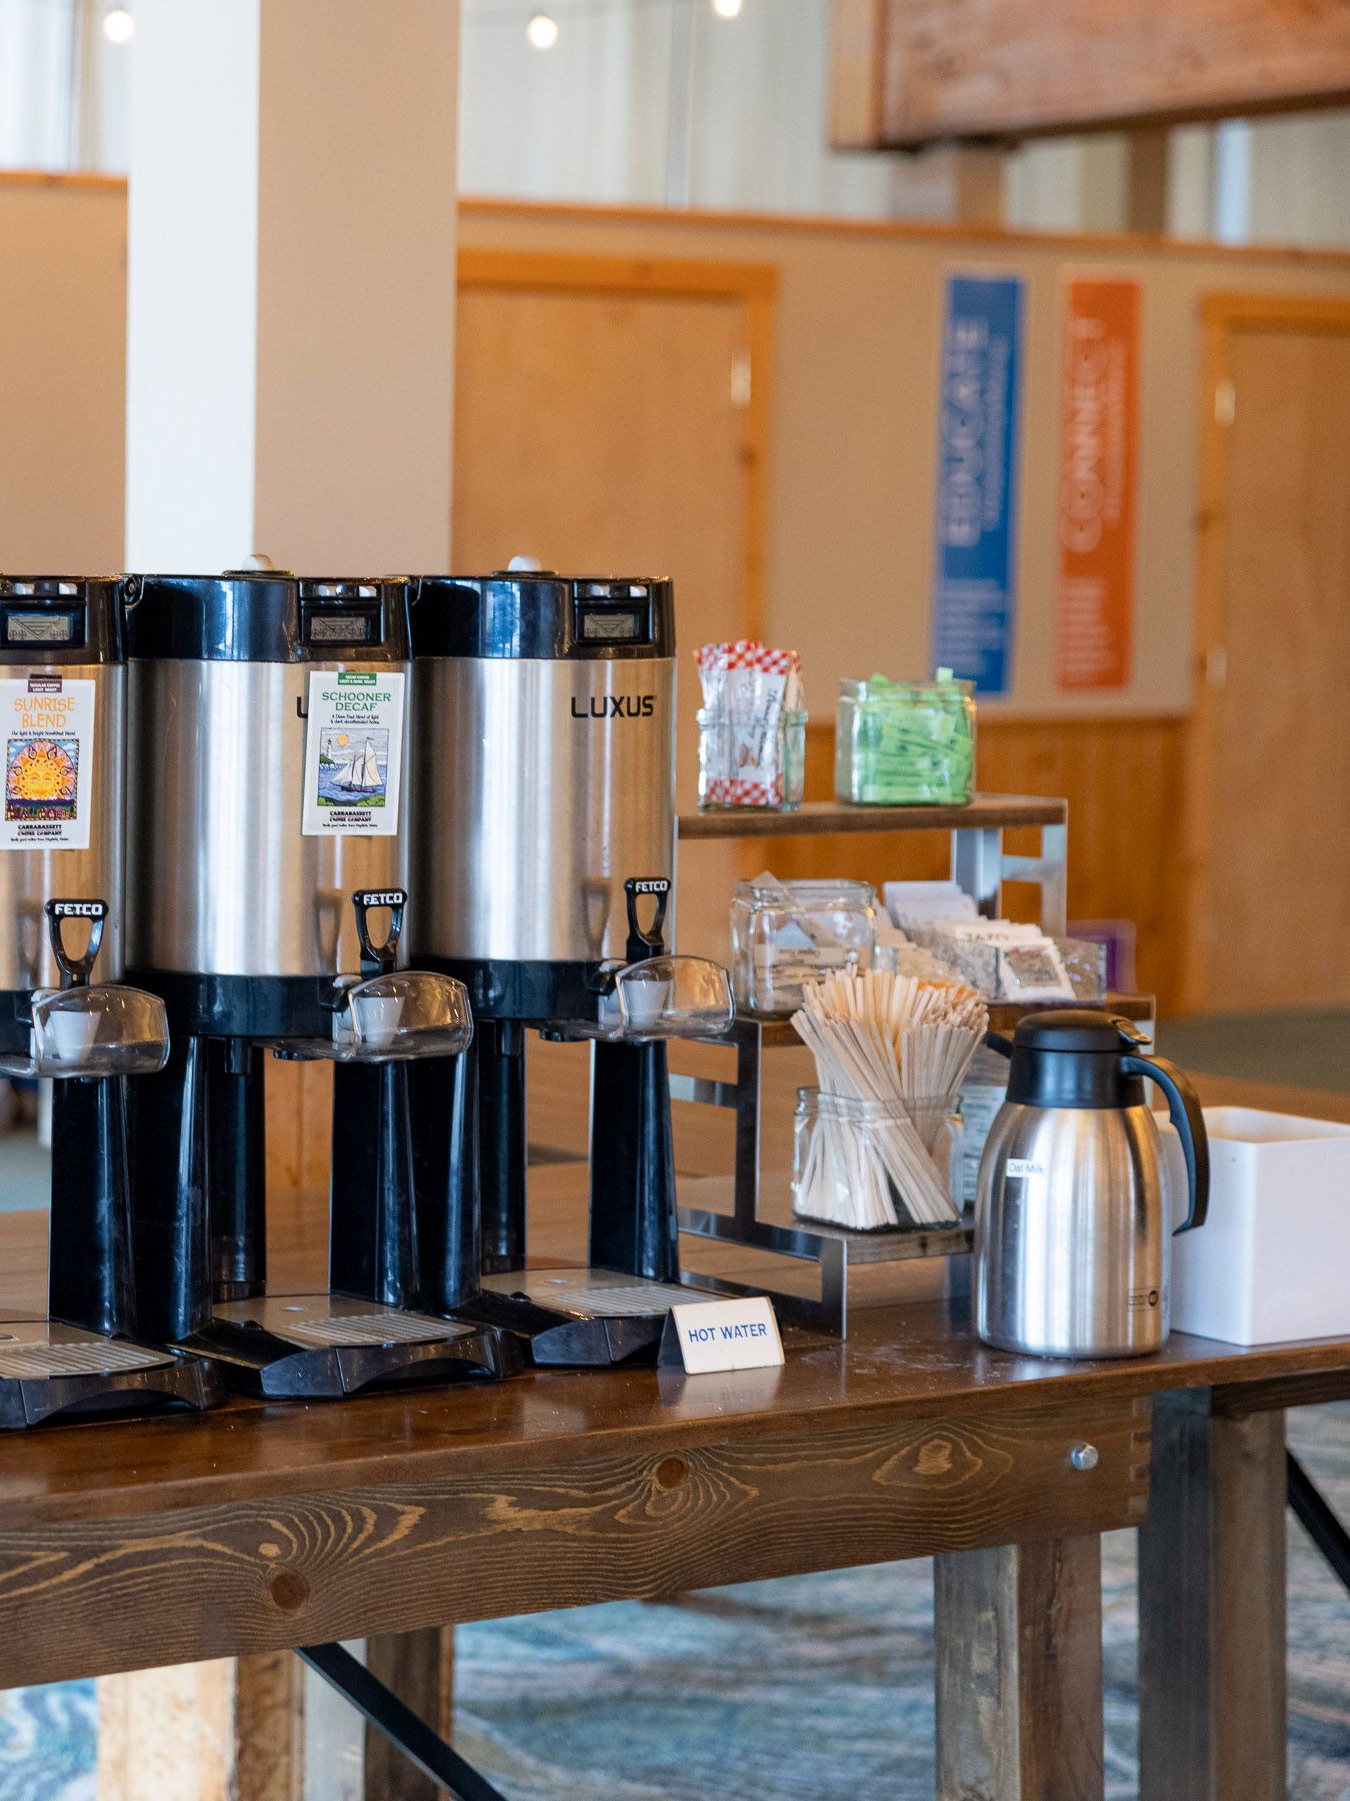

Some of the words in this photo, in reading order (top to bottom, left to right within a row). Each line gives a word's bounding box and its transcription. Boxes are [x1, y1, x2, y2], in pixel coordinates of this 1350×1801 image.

[941, 316, 988, 547] EDUCATE
[1062, 318, 1104, 553] CONNECT
[13, 696, 75, 712] SUNRISE
[322, 692, 391, 702] SCHOONER
[335, 702, 377, 712] DECAF
[571, 695, 655, 718] LUXUS
[22, 712, 66, 728] BLEND
[635, 880, 668, 892] FETCO
[363, 892, 403, 906] FETCO
[54, 903, 103, 915] FETCO
[1009, 1162, 1024, 1173] Oat
[688, 1327, 716, 1343] HOT
[719, 1323, 767, 1340] WATER
